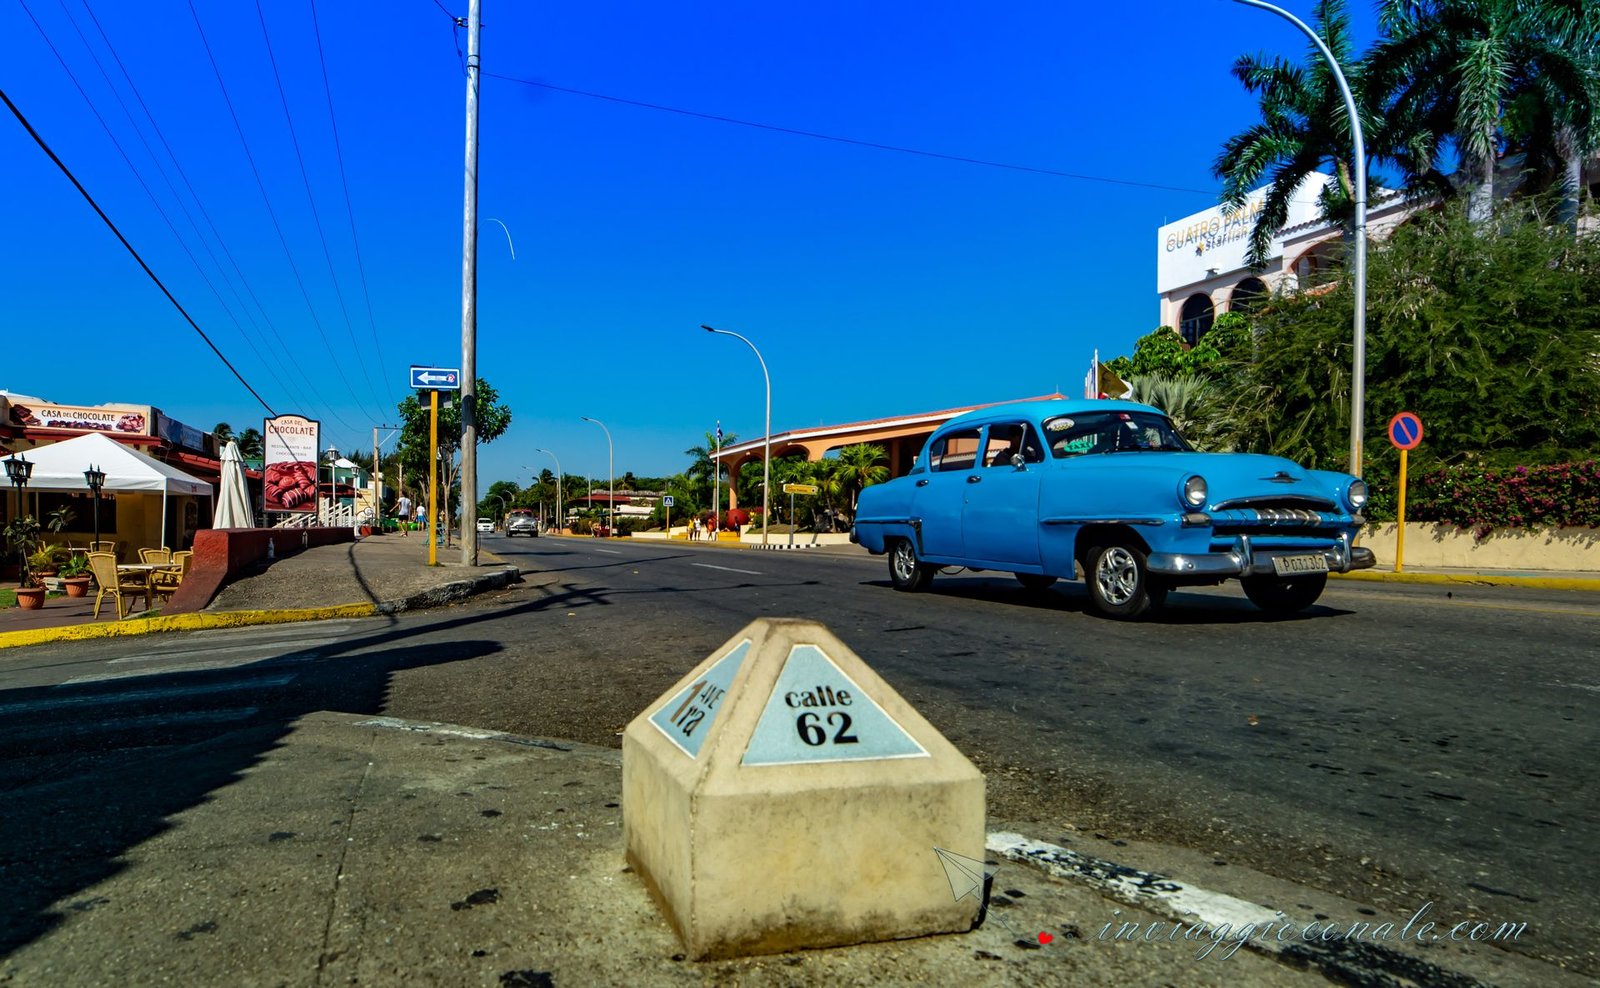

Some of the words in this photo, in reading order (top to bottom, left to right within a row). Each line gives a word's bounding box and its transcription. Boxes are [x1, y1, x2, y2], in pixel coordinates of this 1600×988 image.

[1166, 217, 1220, 252] CUATRO
[1224, 199, 1266, 231] PALM
[41, 409, 62, 418] CASA
[73, 411, 115, 422] CHOCOLATE
[268, 425, 315, 436] CHOCOLATE
[1067, 442, 1090, 451] TAXI
[701, 683, 726, 710] AVE
[784, 685, 853, 708] calle
[796, 711, 859, 747] 62
